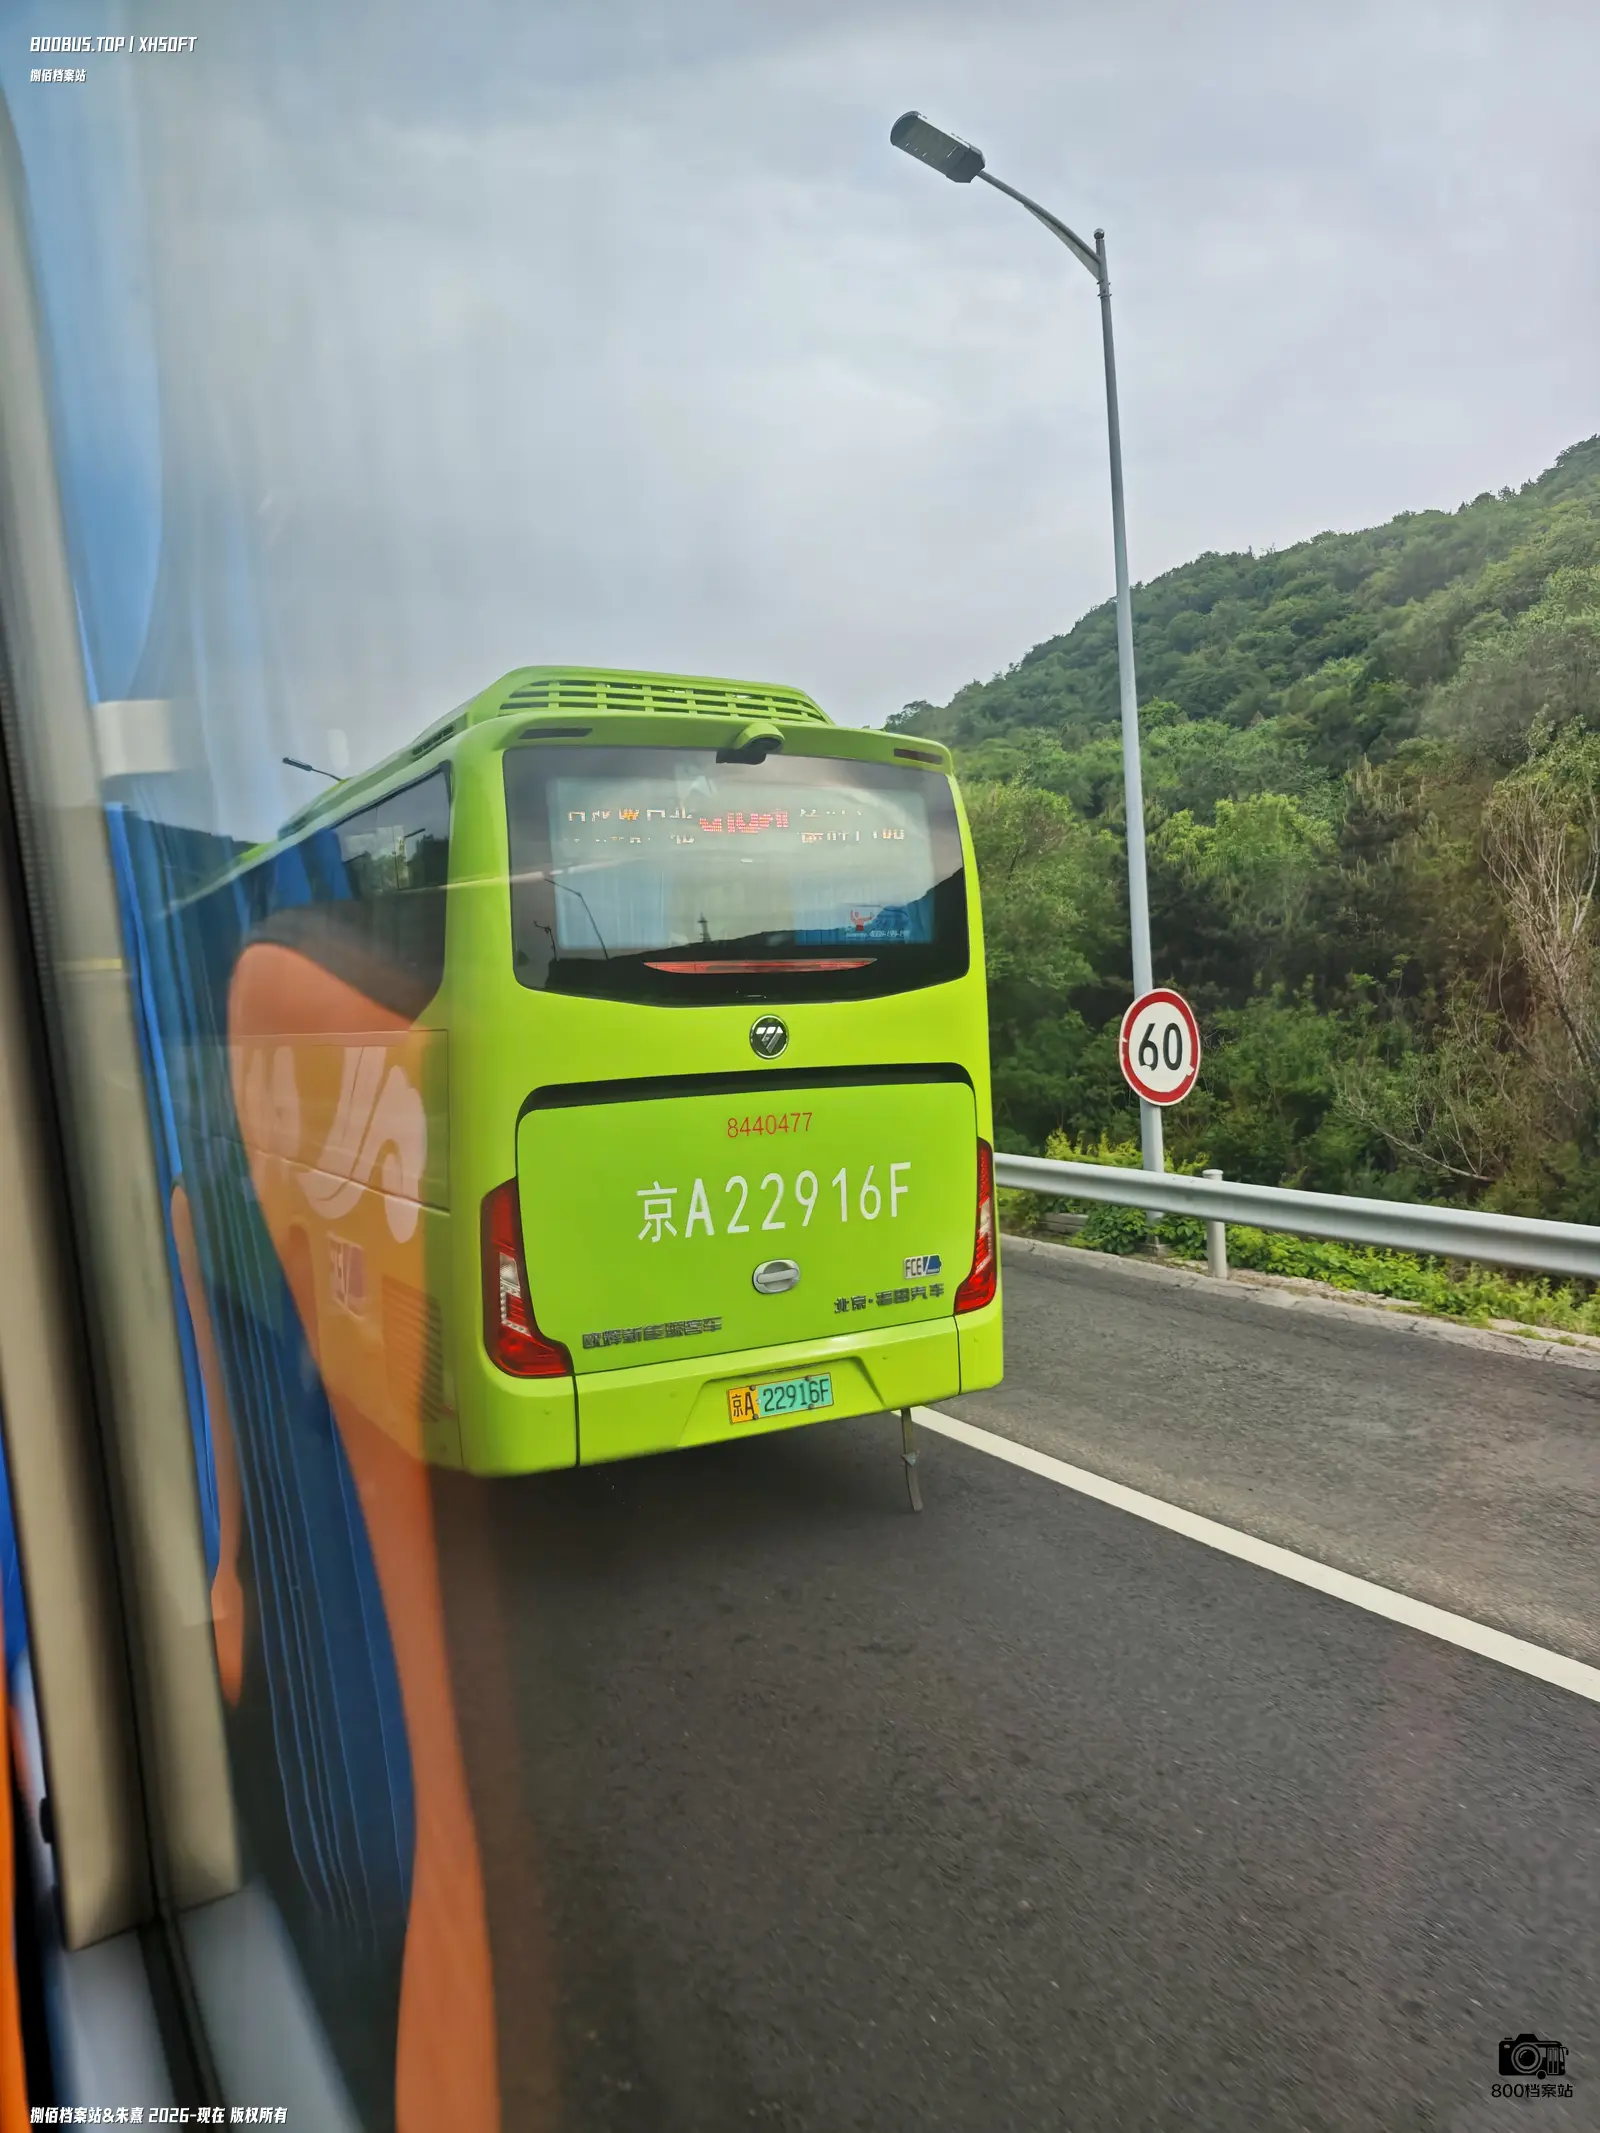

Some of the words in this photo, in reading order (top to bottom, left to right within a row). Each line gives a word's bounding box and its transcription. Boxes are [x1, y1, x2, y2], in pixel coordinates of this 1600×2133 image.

[1138, 1022, 1183, 1071] 60
[727, 1112, 812, 1138] 8440477
[636, 1161, 911, 1243] 京A22916F
